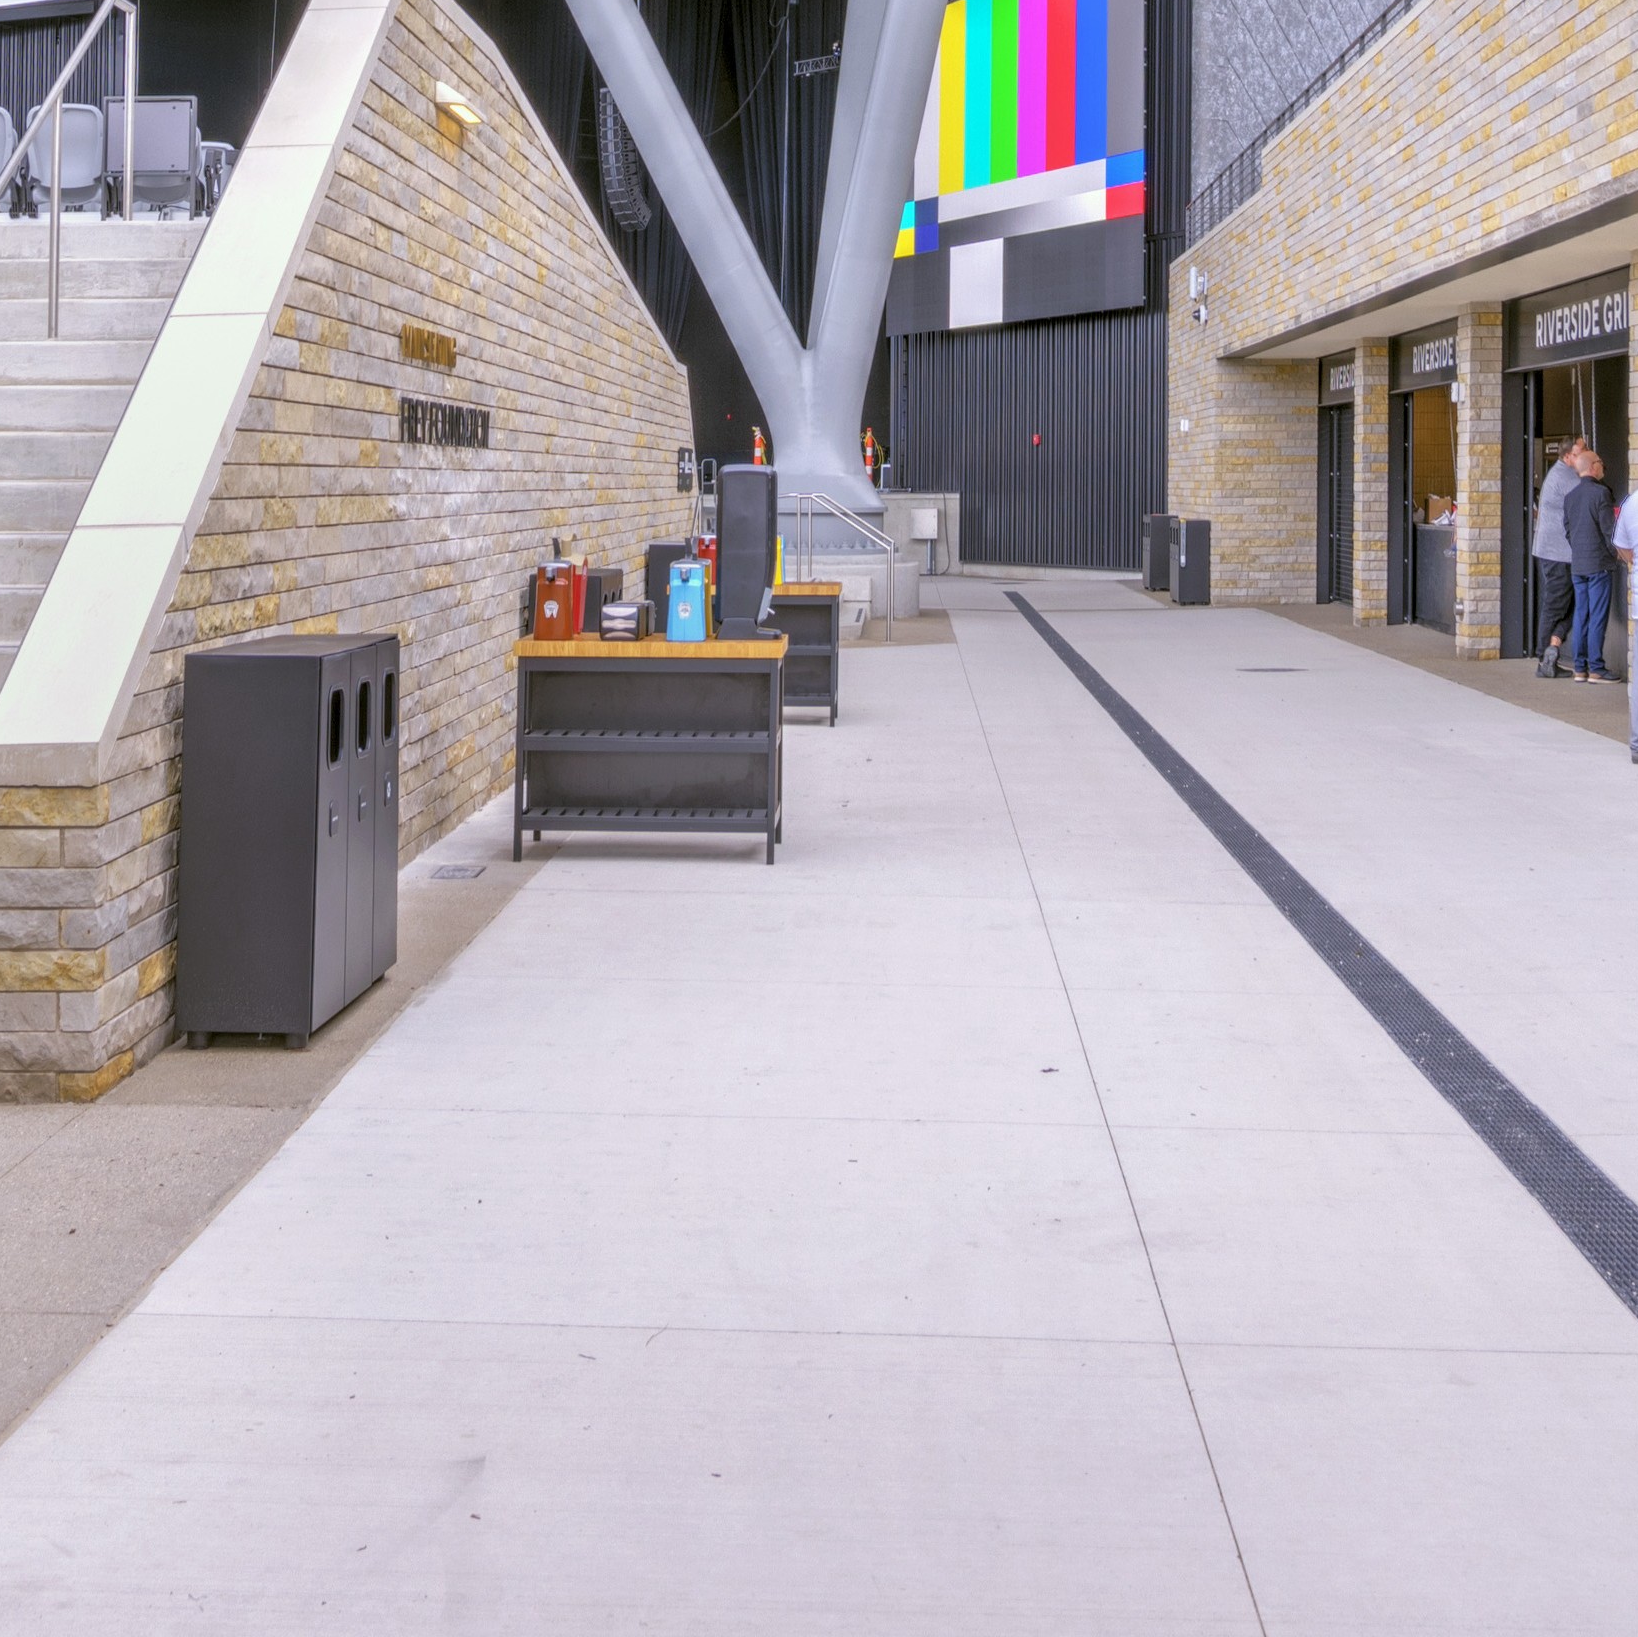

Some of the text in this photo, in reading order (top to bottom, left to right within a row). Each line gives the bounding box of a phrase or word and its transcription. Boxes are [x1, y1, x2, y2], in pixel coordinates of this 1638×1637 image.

[1535, 291, 1627, 348] RIVERSIDE GRI
[1413, 337, 1454, 374] RIVERSIDE
[399, 396, 490, 449] FREY FOUNDATION
